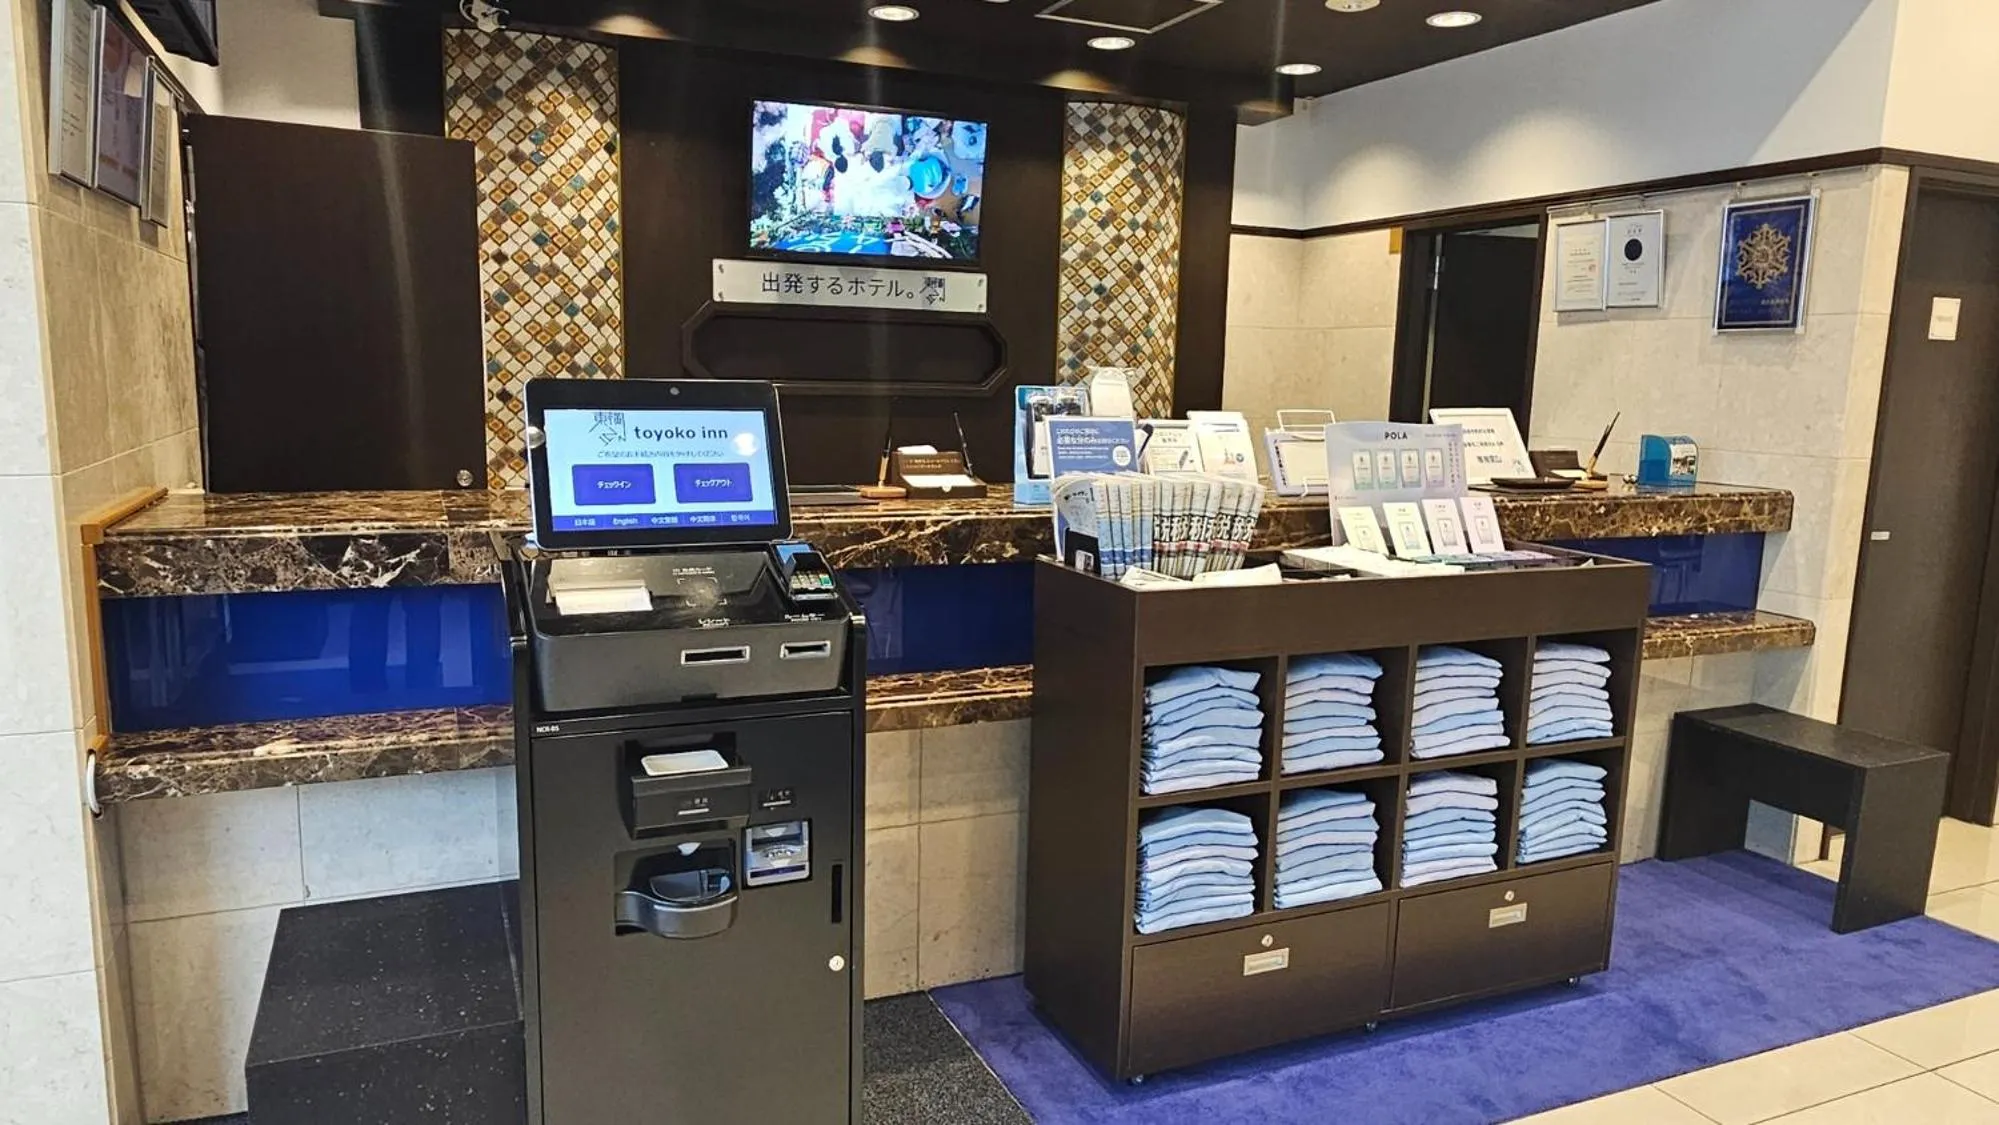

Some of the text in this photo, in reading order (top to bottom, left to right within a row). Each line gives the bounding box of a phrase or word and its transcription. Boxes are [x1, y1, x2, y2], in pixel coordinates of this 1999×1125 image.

[761, 271, 914, 300] 出発するホテル。
[633, 425, 729, 442] toyoko inn
[1384, 431, 1408, 440] POLA
[596, 480, 632, 490] チェックイン
[694, 478, 734, 488] チェックアウト
[612, 517, 639, 527] English
